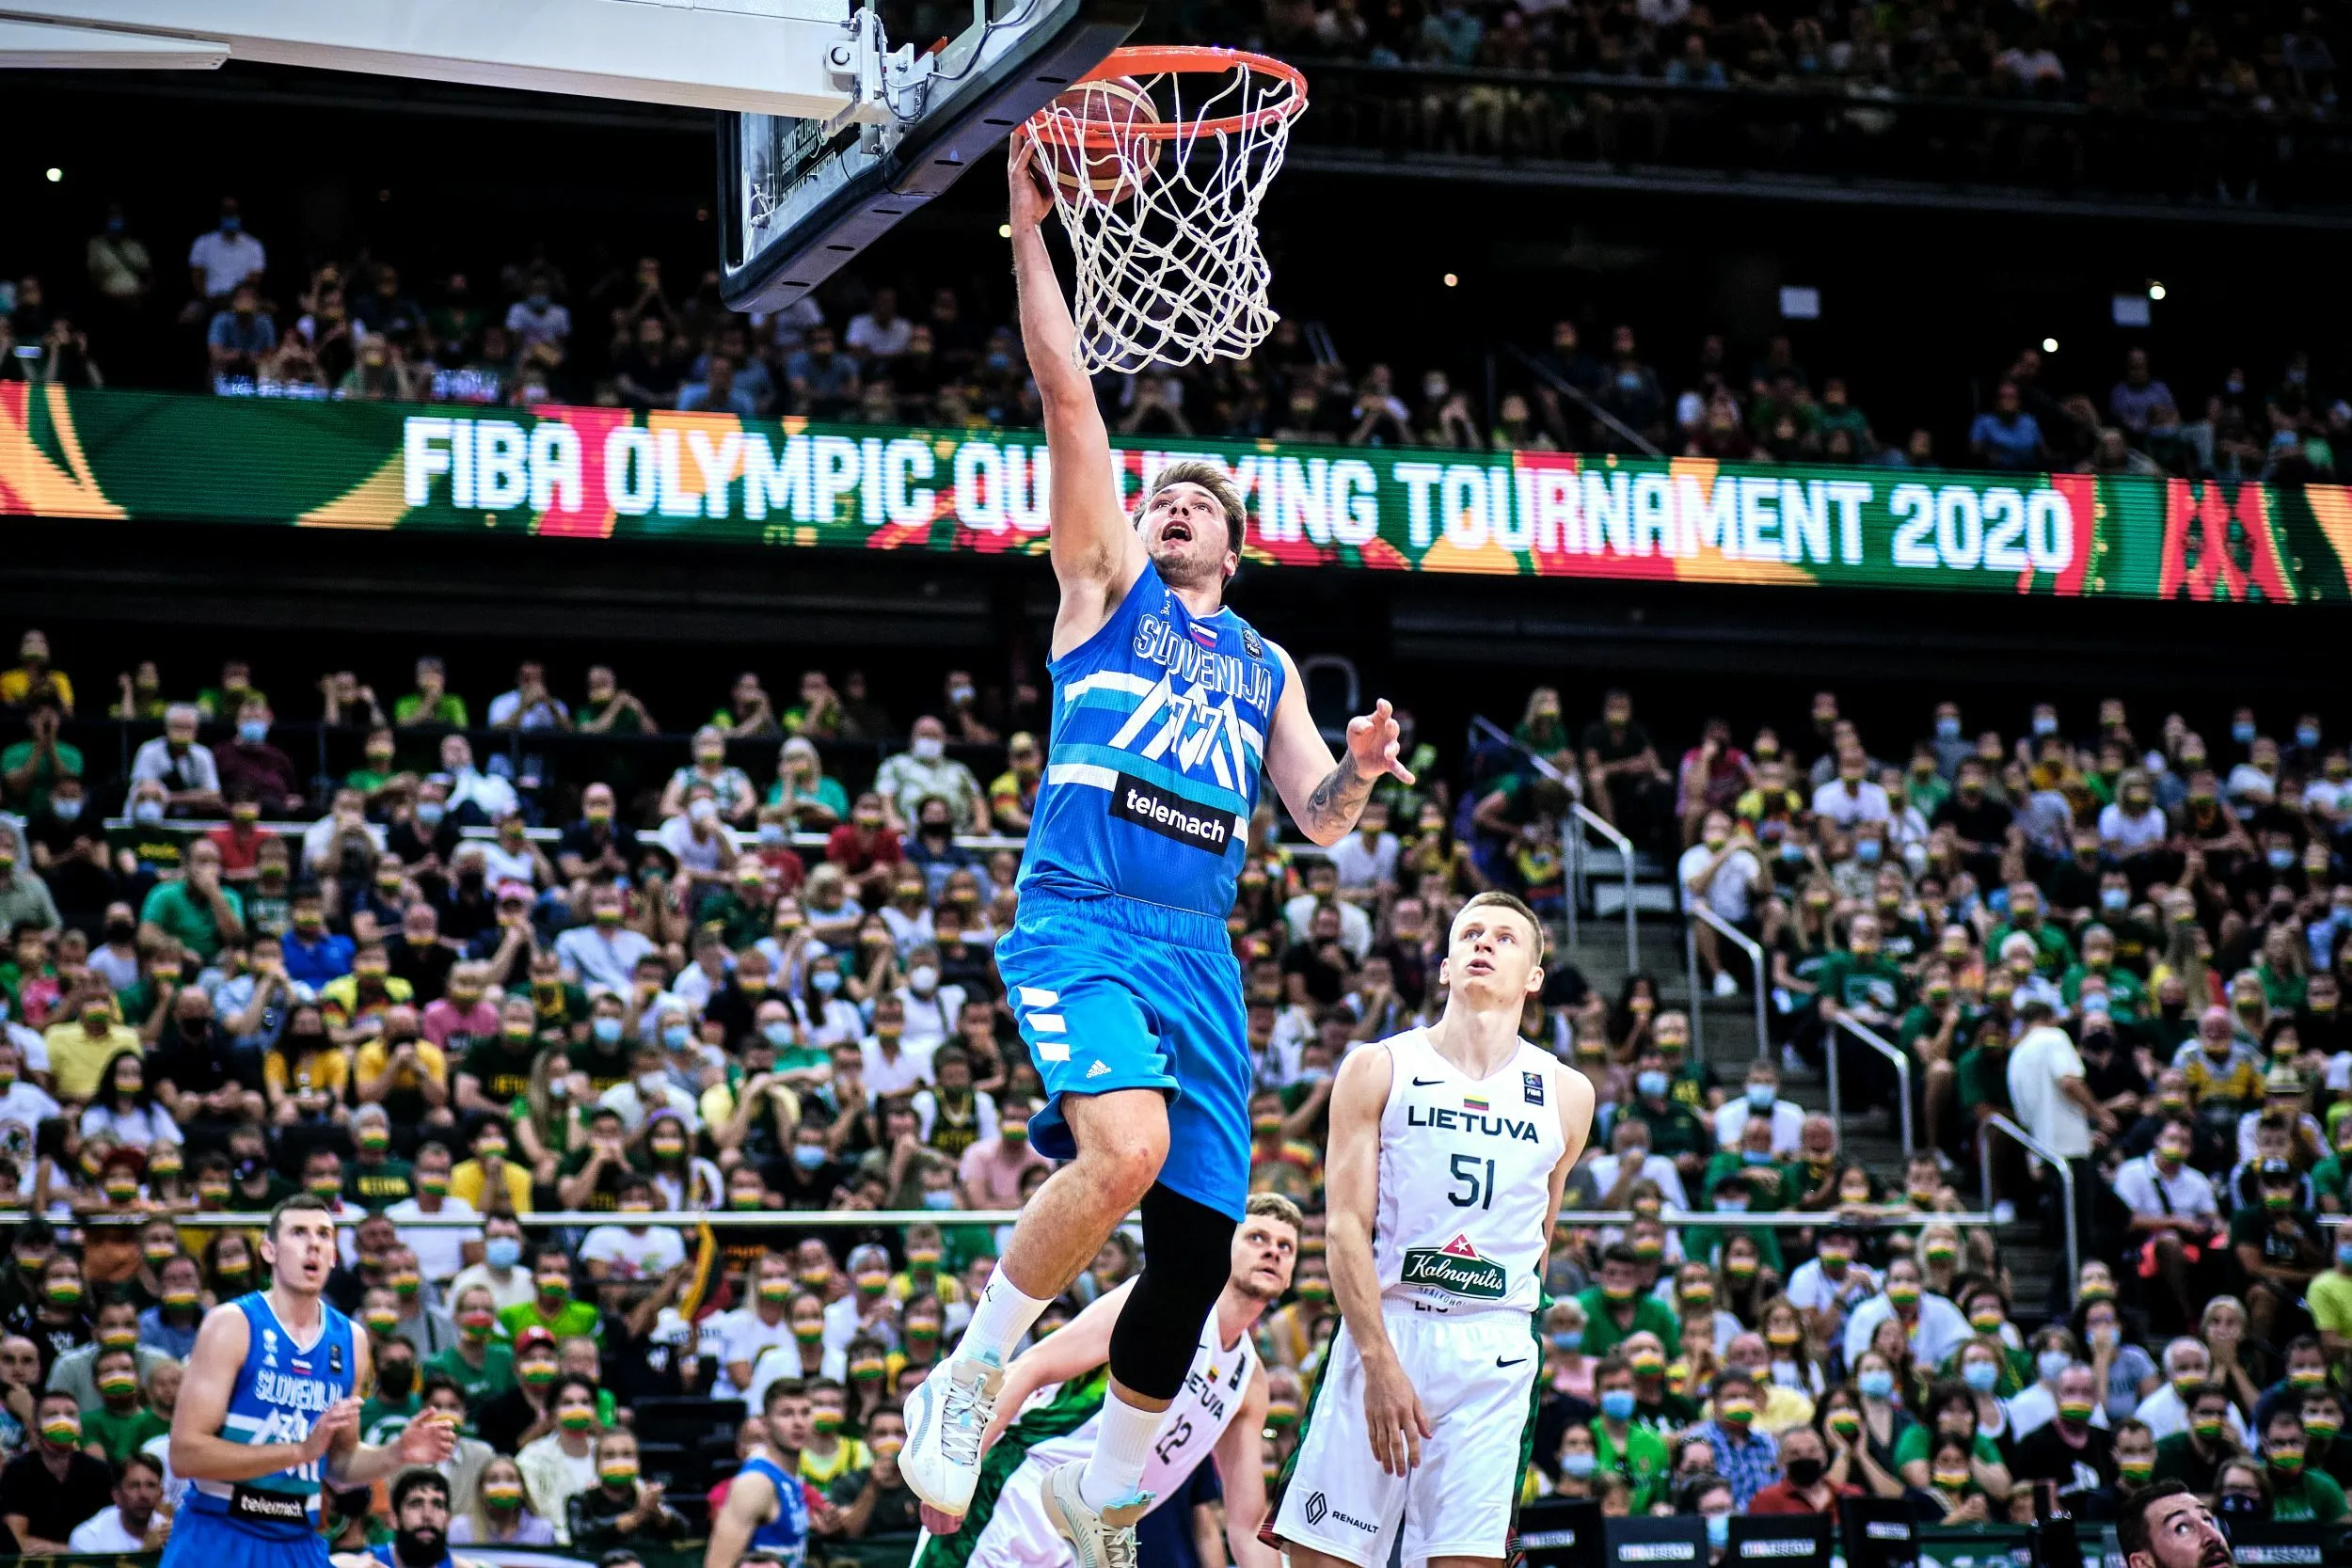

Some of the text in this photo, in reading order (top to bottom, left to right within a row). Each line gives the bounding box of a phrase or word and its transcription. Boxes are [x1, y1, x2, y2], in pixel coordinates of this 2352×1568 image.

[404, 416, 583, 513] FIBA
[603, 426, 935, 527] OLYMPIC
[1393, 462, 1874, 565] TOURNAMENT
[1889, 483, 2074, 574] 2020
[1134, 614, 1271, 718] SLOVENIJA
[1126, 788, 1225, 843] telemach
[1407, 1105, 1539, 1144] LIETUVA
[1447, 1153, 1495, 1211] 51
[1405, 1254, 1504, 1291] Kalnapilis
[1155, 1413, 1192, 1465] 22
[1332, 1511, 1380, 1534] RENAULT
